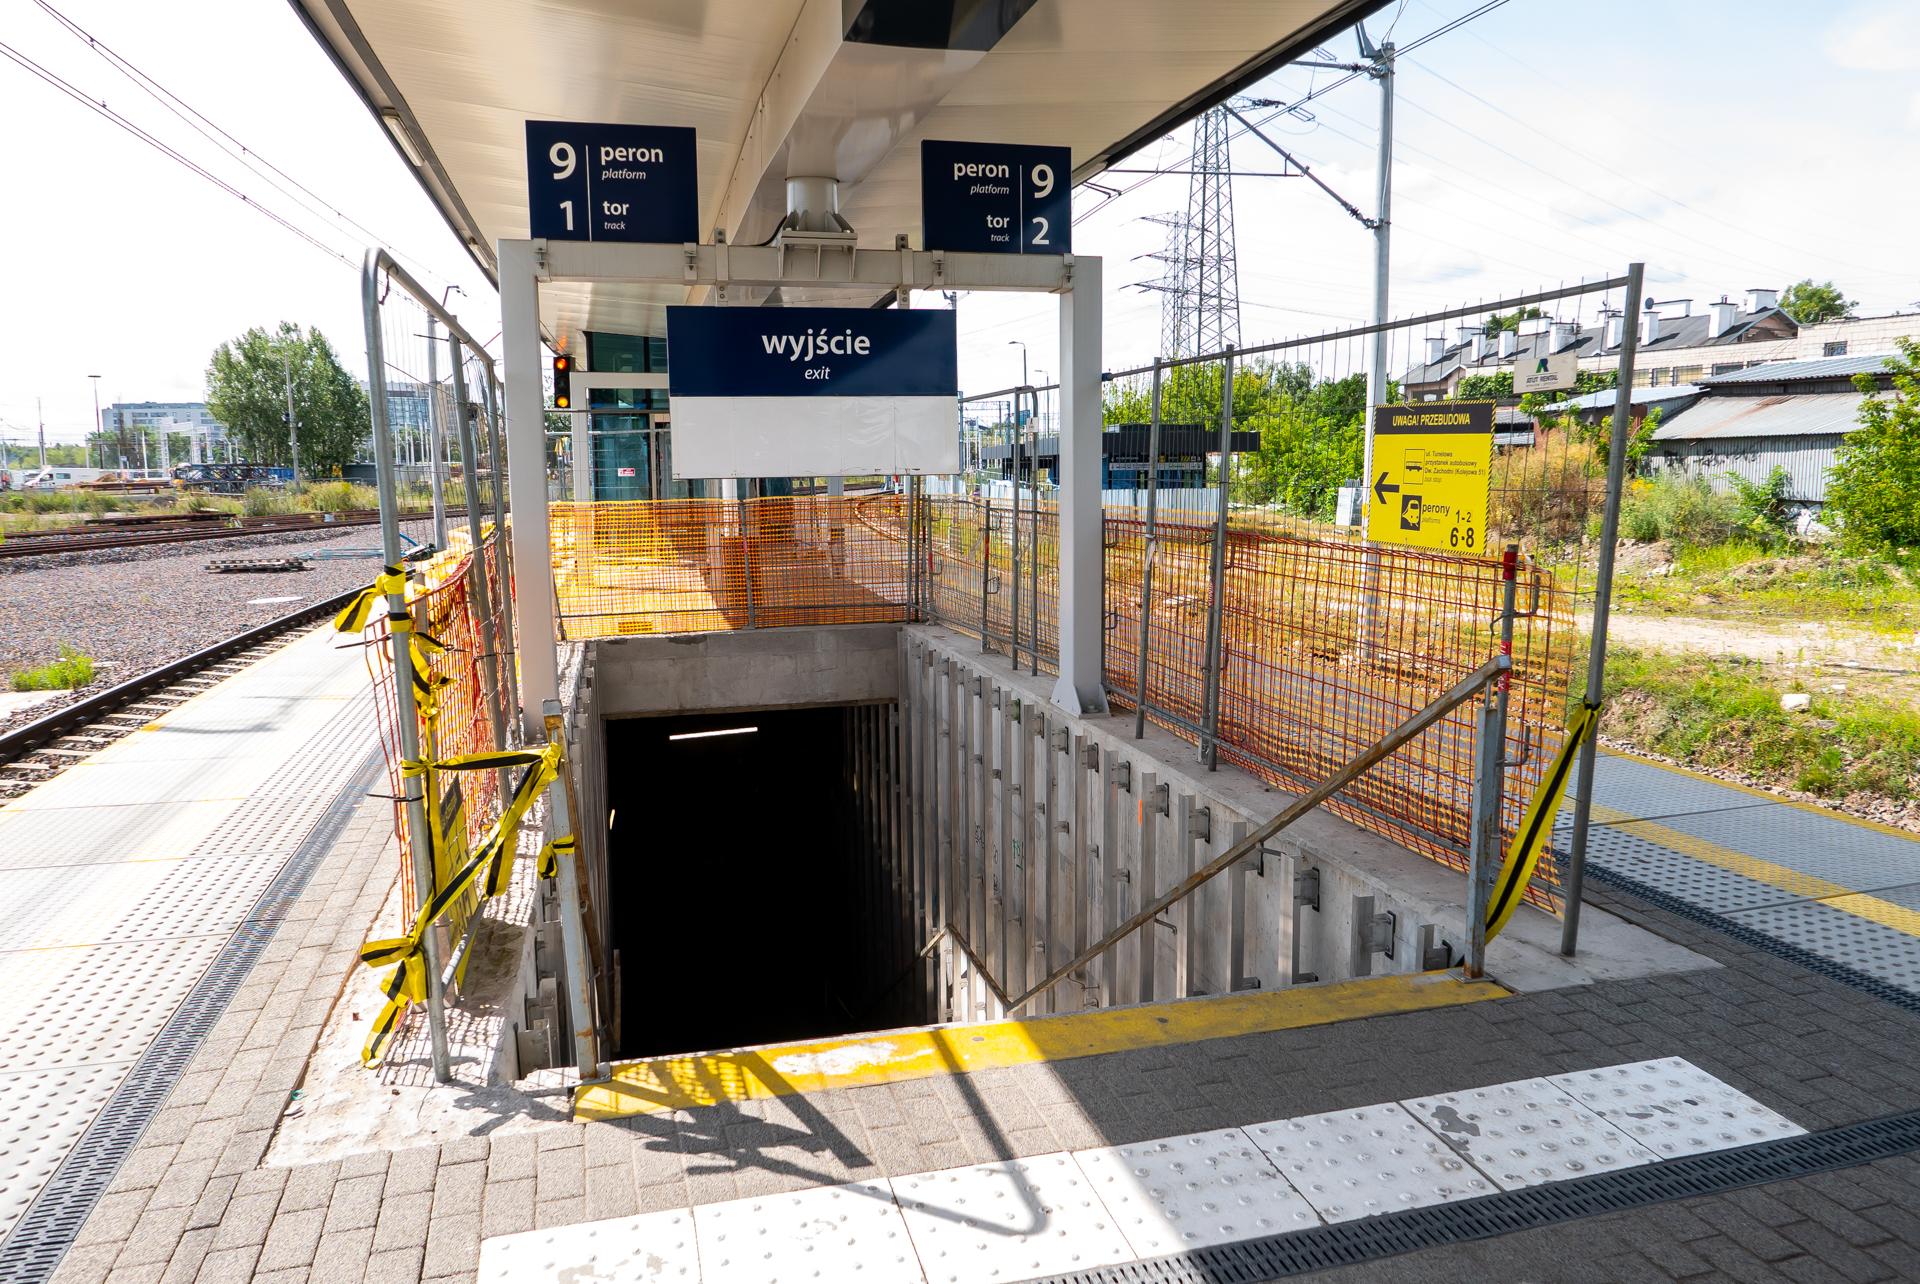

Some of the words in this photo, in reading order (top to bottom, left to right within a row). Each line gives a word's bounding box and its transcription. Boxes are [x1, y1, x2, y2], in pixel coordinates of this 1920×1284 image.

[549, 142, 576, 180] 9
[600, 145, 664, 166] peron
[602, 168, 647, 181] platform
[953, 162, 1010, 181] peron
[1031, 164, 1055, 199] 9
[970, 184, 1010, 196] platform
[559, 200, 574, 231] 1
[603, 200, 630, 216] tor
[604, 221, 626, 230] track
[986, 214, 1010, 229] tor
[1031, 216, 1050, 245] 2
[990, 233, 1010, 243] track
[761, 327, 871, 362] wyjście
[804, 366, 831, 380] exit
[1392, 415, 1419, 426] UWAGA!
[1420, 413, 1470, 425] PRZEBUDOWA
[1422, 504, 1450, 517] perony
[1455, 510, 1472, 523] 1-2
